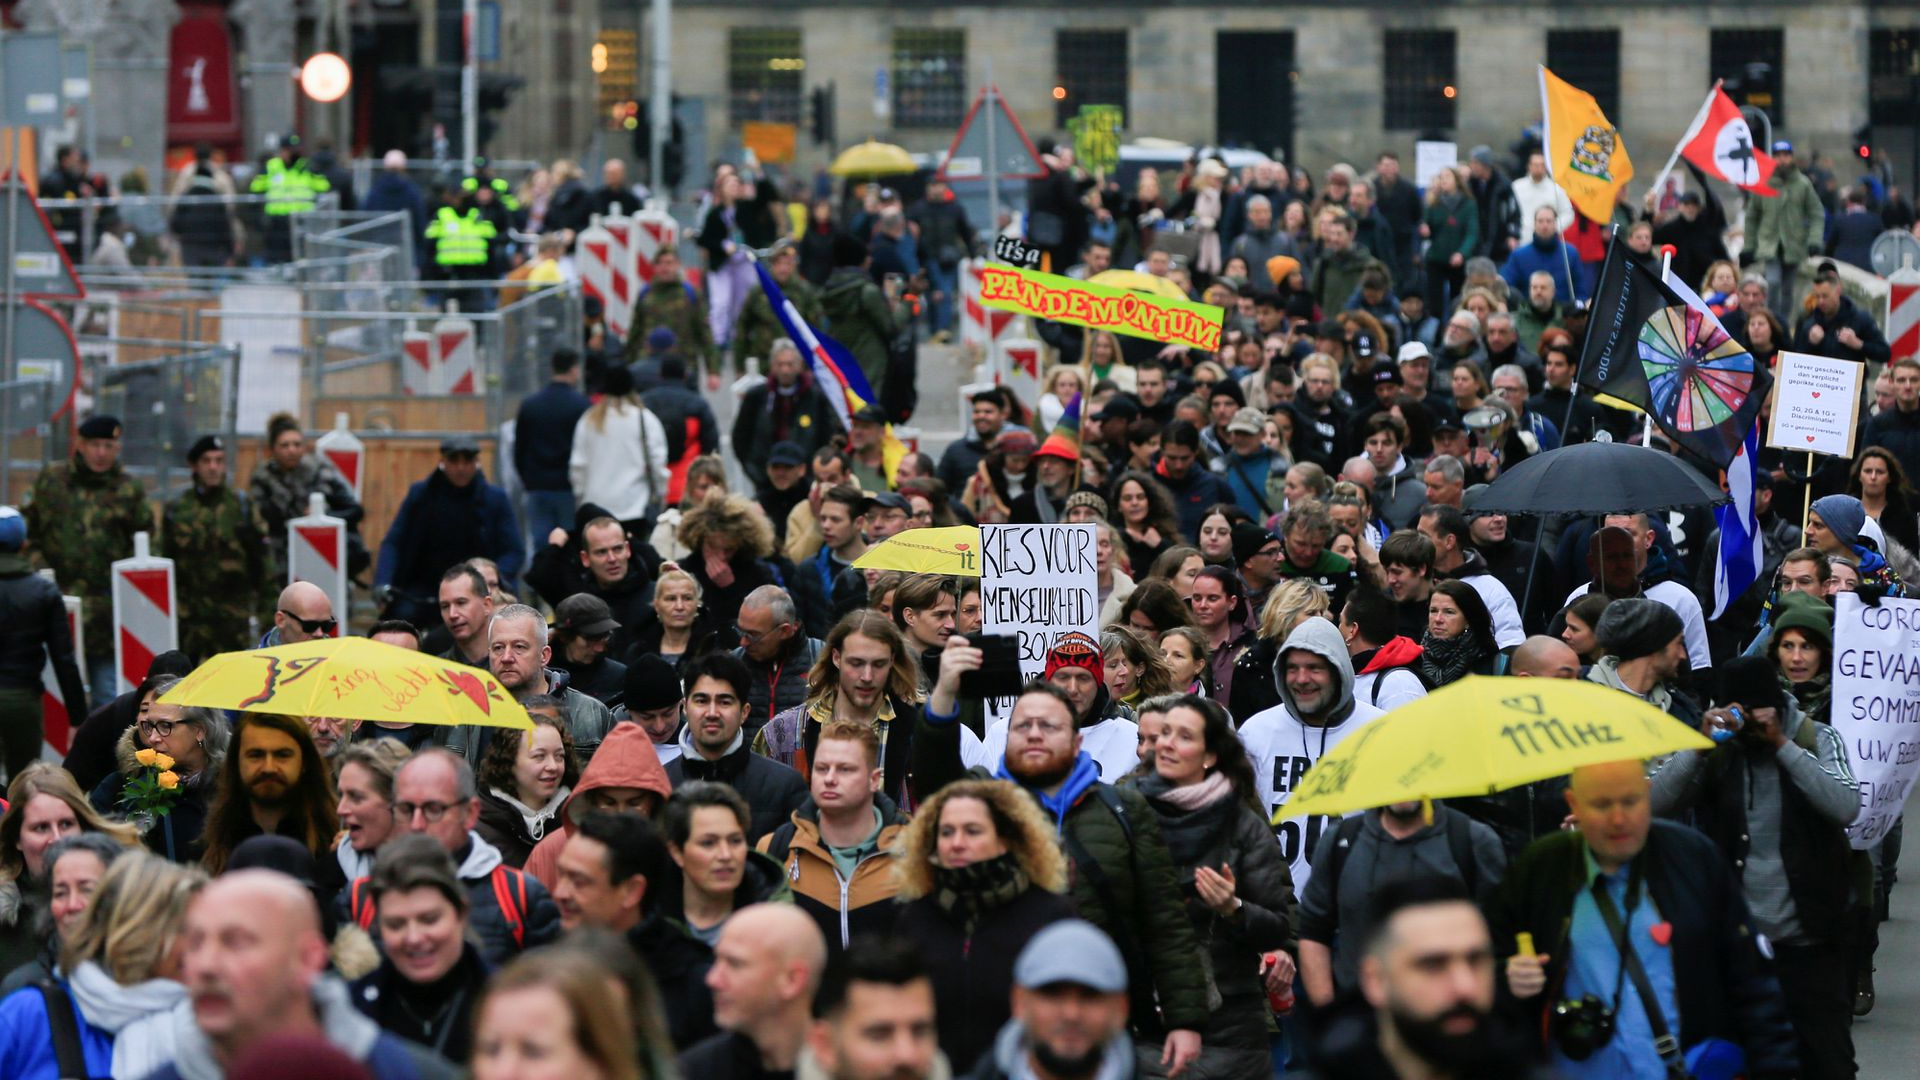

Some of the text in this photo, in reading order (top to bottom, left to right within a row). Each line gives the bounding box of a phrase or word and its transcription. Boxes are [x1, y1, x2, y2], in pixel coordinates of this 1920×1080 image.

[997, 237, 1040, 263] it's a
[981, 267, 1222, 351] PANDEMONIUM
[1793, 362, 1845, 376] Liever geschikte
[1811, 374, 1839, 383] verplicht
[1791, 413, 1835, 424] Discriminatie!
[980, 526, 1096, 579] KIES VOOR
[983, 586, 1094, 627] MENSELIJKHEID
[1858, 738, 1893, 763] UW
